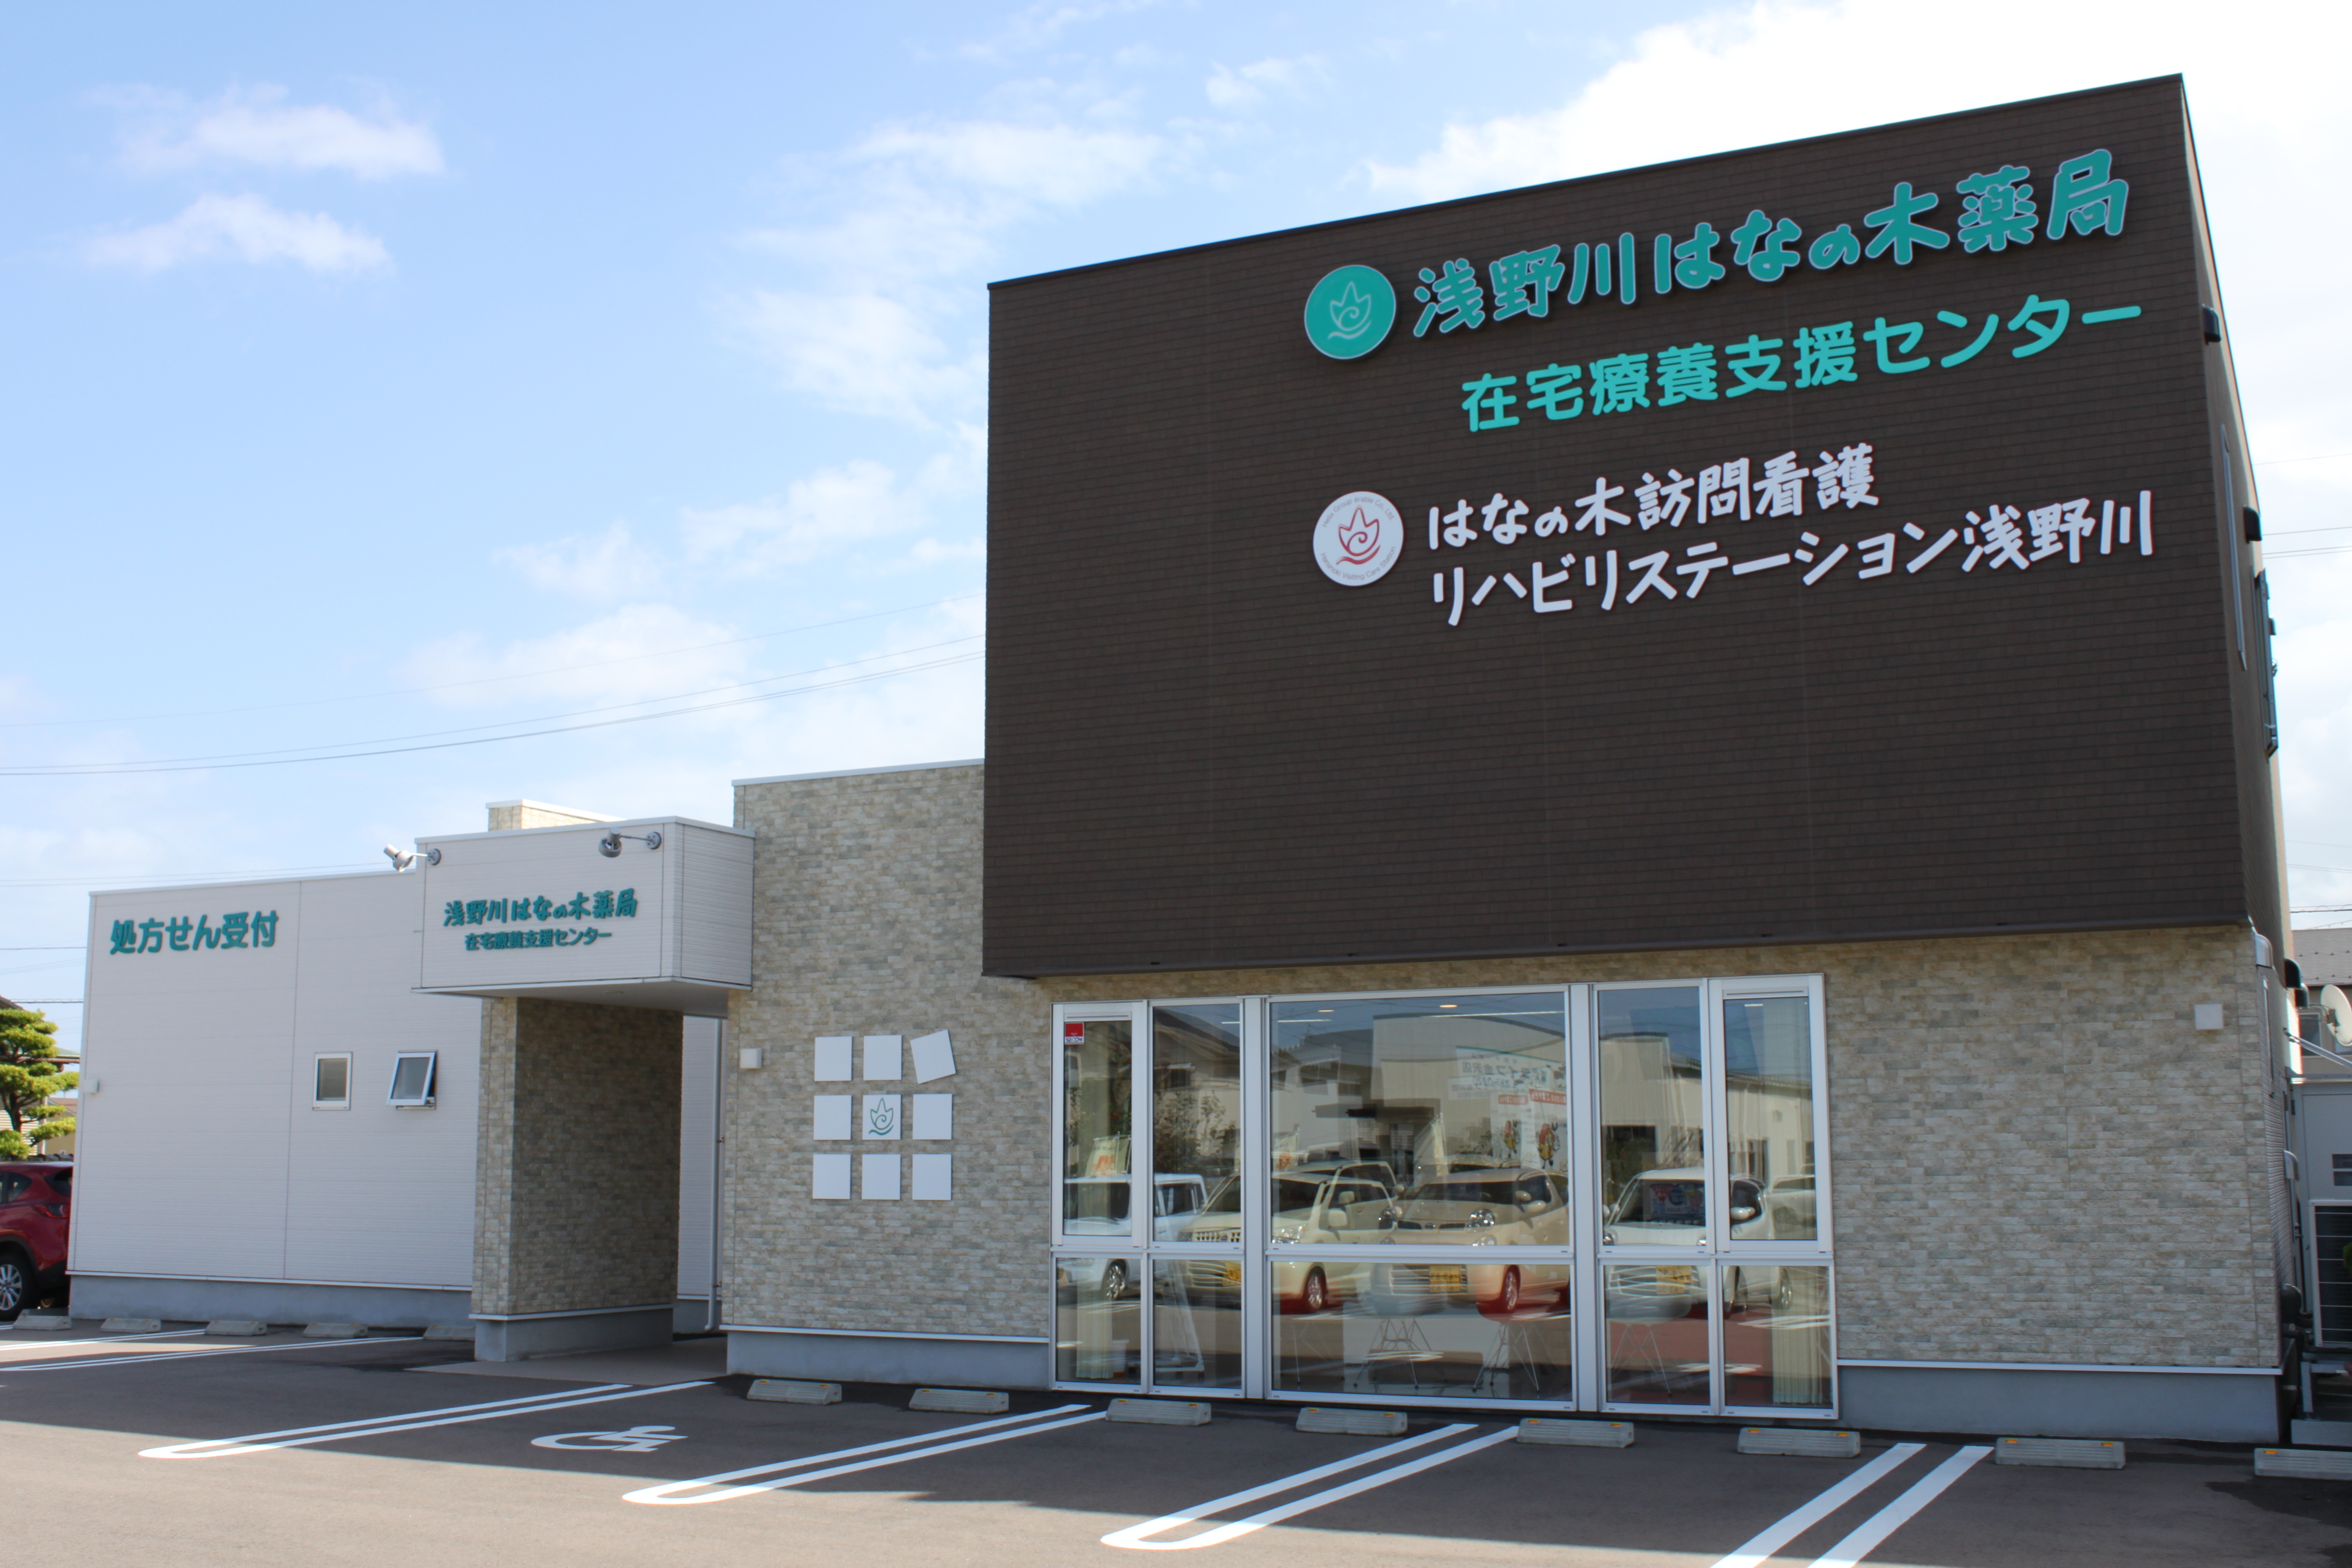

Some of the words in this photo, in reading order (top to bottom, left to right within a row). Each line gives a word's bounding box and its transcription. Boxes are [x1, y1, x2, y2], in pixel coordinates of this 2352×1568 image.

[1413, 148, 2130, 339] 浅野川はなの木薬局
[1461, 294, 2142, 432] 在宅療養支援センター
[1333, 499, 1353, 513] Group
[1428, 442, 1879, 550] はなの木訪問看護
[1366, 567, 1380, 578] Care
[1432, 490, 2154, 627] リハビリステーション浅野川
[443, 888, 638, 927] 浅野川はなの木薬局
[109, 910, 279, 955] 処方せん受付
[464, 927, 612, 951] 在宅療養支援センター
